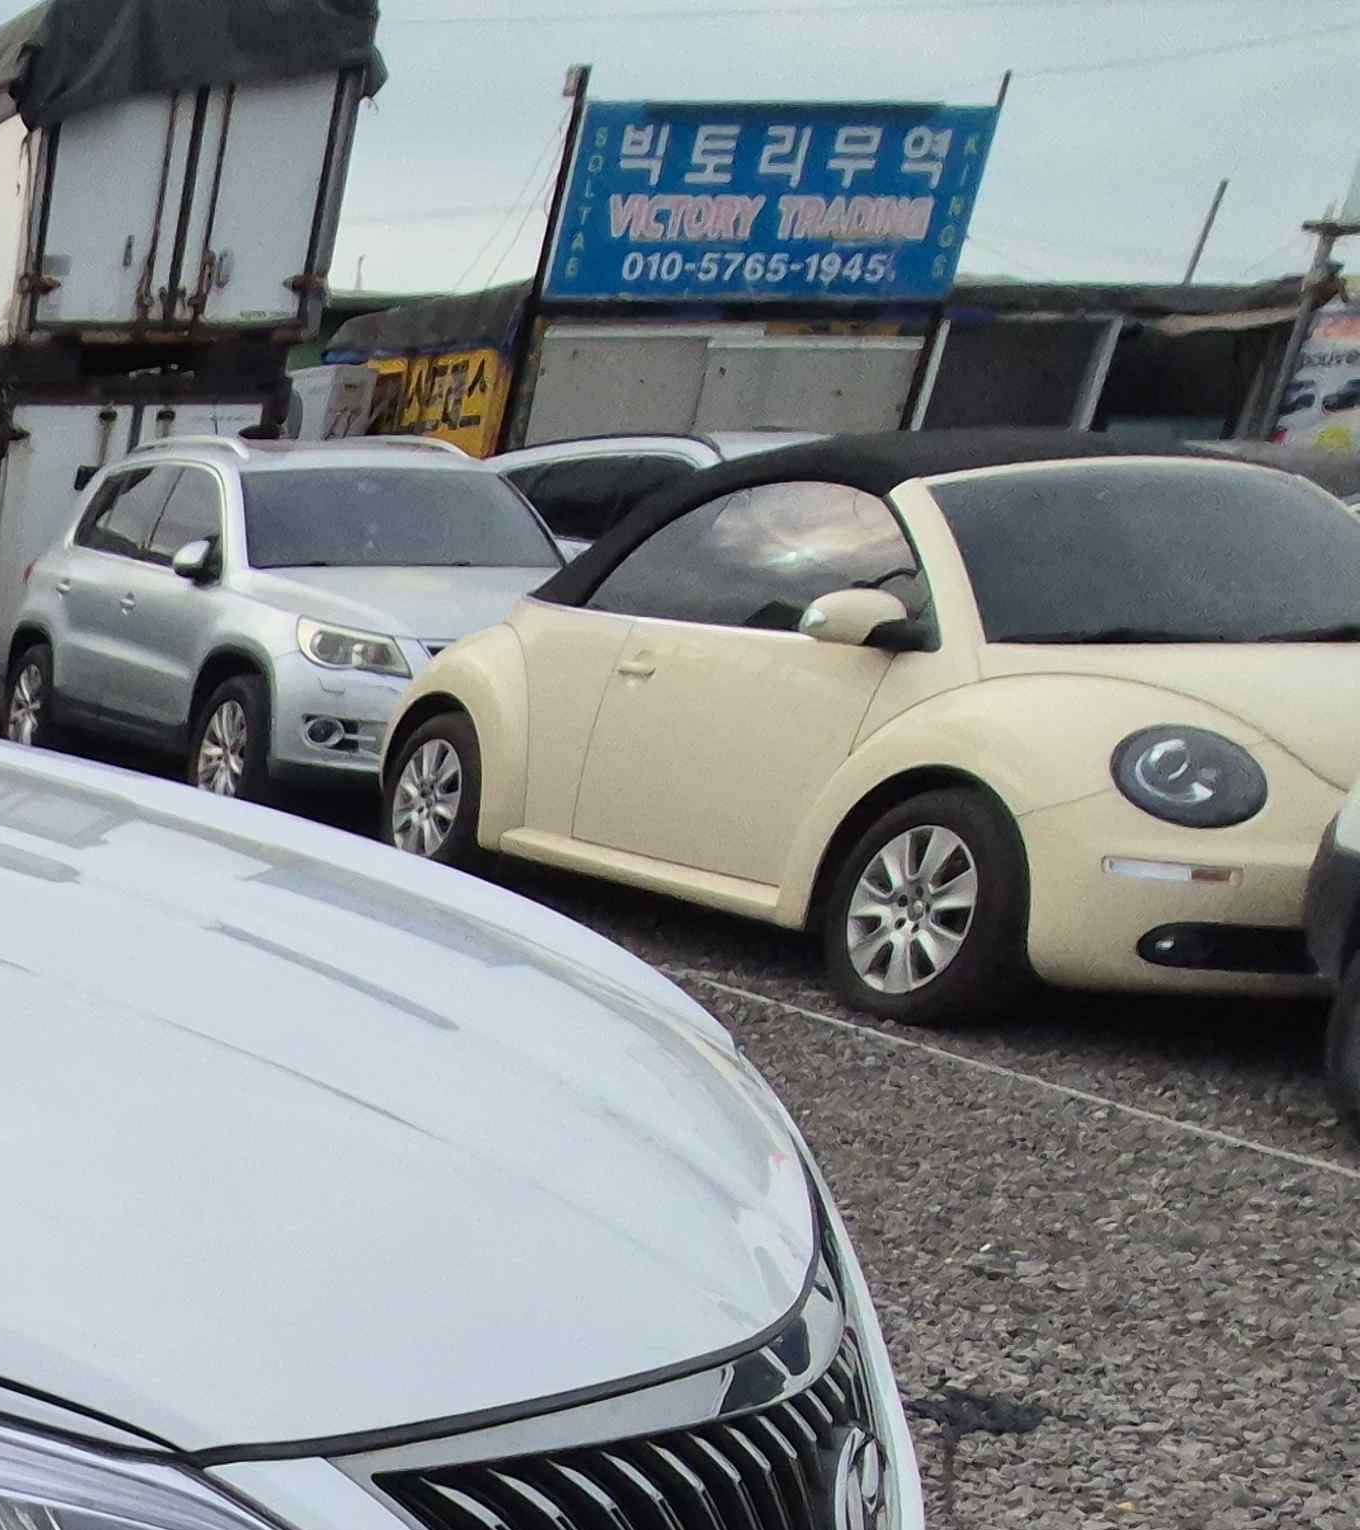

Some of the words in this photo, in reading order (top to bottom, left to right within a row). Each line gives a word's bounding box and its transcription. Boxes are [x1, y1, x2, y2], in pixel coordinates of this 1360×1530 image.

[619, 123, 953, 189] 빅토리무역
[608, 193, 767, 242] VICTORY
[777, 194, 935, 242] TRADING
